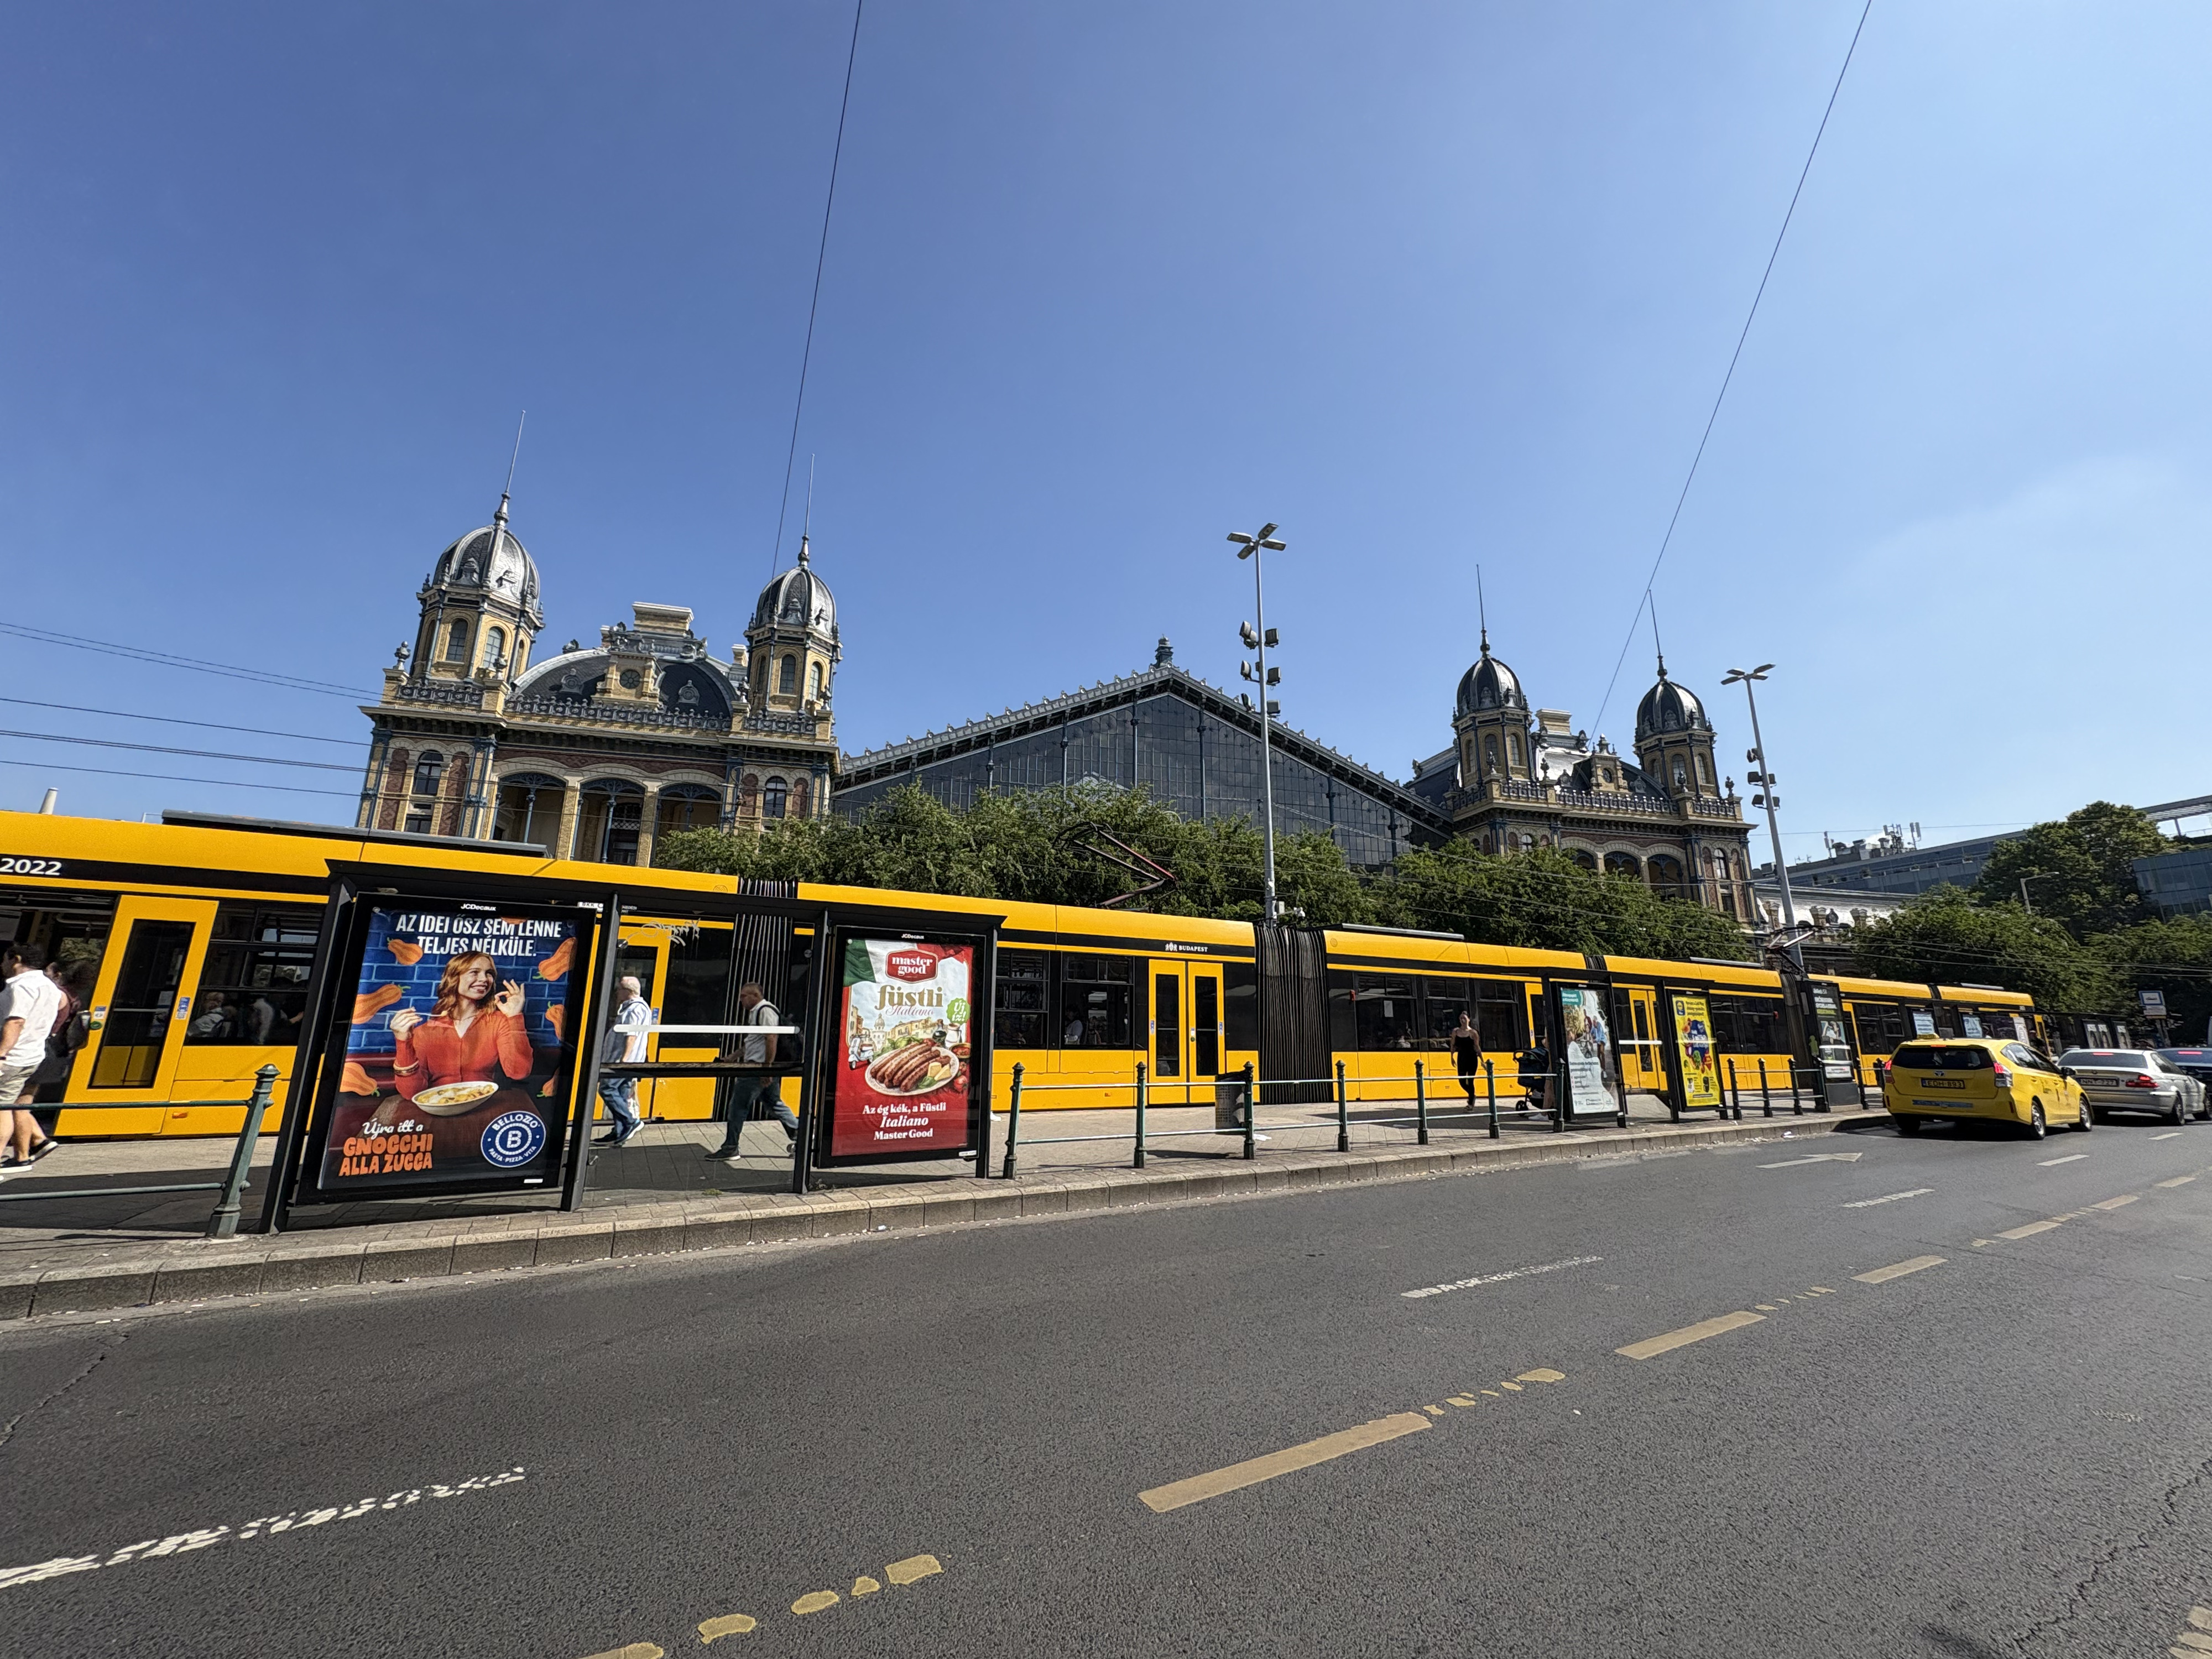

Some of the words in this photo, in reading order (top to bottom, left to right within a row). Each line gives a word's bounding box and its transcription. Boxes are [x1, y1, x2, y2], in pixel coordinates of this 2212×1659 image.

[0, 858, 62, 875] 2022
[395, 914, 418, 932] AZ
[418, 915, 450, 933] IDEI
[452, 914, 482, 935] ŐSZ
[483, 918, 515, 936] SEM
[518, 920, 562, 937] LENNE
[417, 936, 469, 954] TELJES
[472, 935, 536, 957] NÉLKÜLE.
[891, 956, 933, 967] master
[898, 964, 927, 977] good
[874, 984, 943, 1011] füstli
[885, 1004, 935, 1016] Italiano
[954, 1000, 966, 1014] Új
[862, 1105, 875, 1115] Az
[877, 1104, 889, 1115] ég
[890, 1103, 911, 1115] kék,
[920, 1102, 946, 1112] Füstli
[362, 1118, 394, 1140] Újra
[397, 1119, 415, 1133] itt
[415, 1124, 424, 1132] a
[492, 1114, 538, 1131] BELLOZZO
[880, 1115, 929, 1128] Italiano
[507, 1130, 522, 1148] B
[873, 1131, 908, 1141] Master
[909, 1128, 933, 1139] Good
[343, 1134, 434, 1157] GNOCCHI
[488, 1148, 503, 1162] PASTA
[524, 1146, 537, 1157] VITA
[338, 1155, 380, 1177] ALLA
[382, 1152, 433, 1173] ZUCCA
